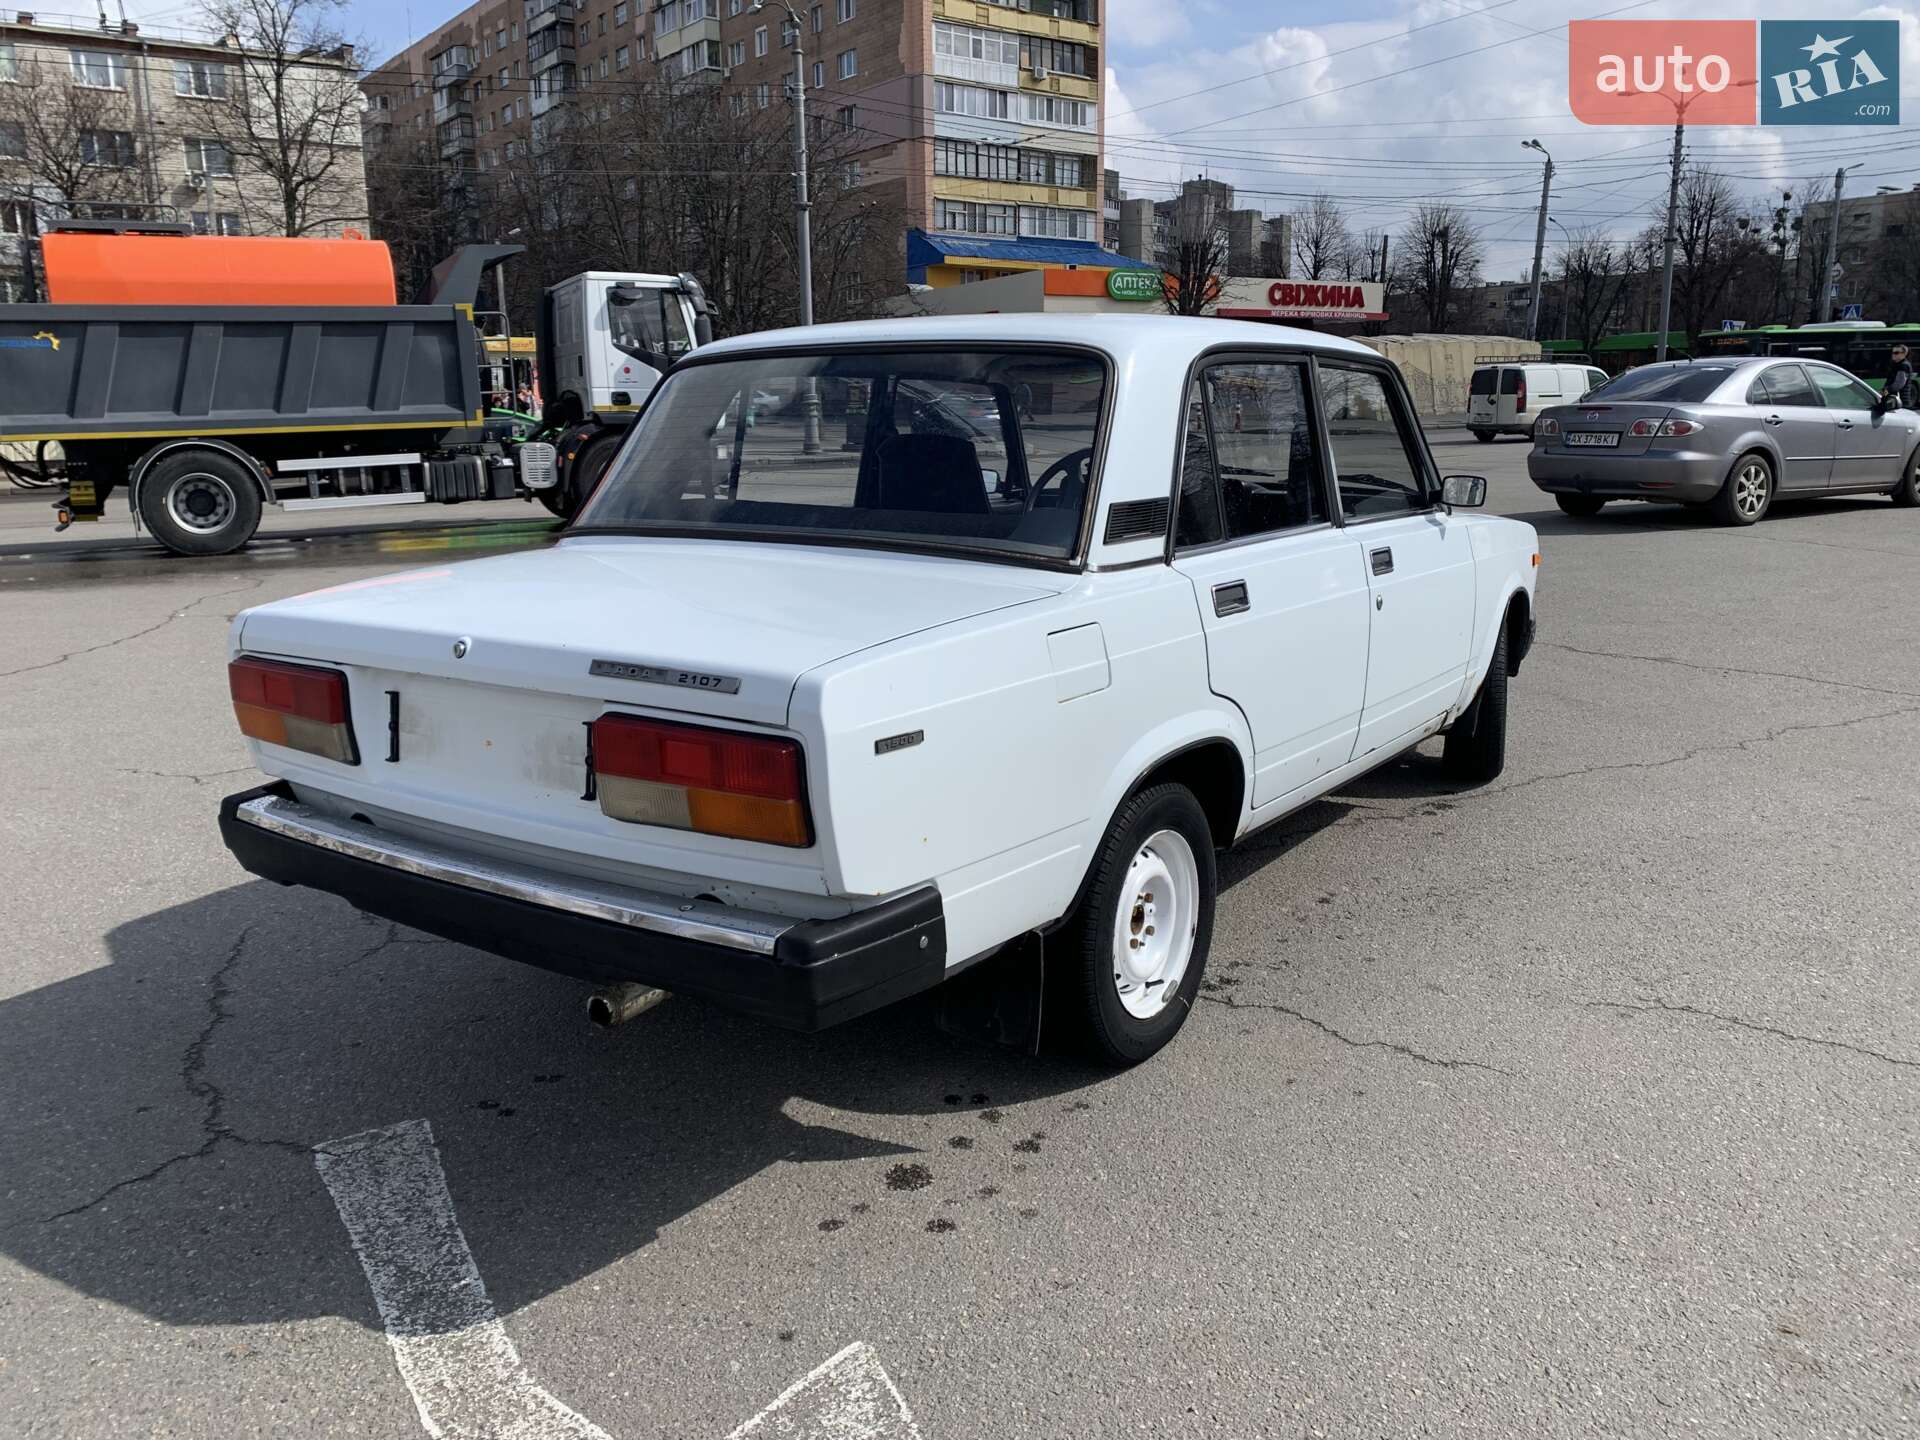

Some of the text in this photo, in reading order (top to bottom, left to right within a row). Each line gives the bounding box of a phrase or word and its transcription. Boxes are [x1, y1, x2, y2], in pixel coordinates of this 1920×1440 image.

[1115, 276, 1161, 289] АПТЕКА
[1268, 282, 1365, 308] СВІЖИНА
[678, 673, 722, 688] 2107
